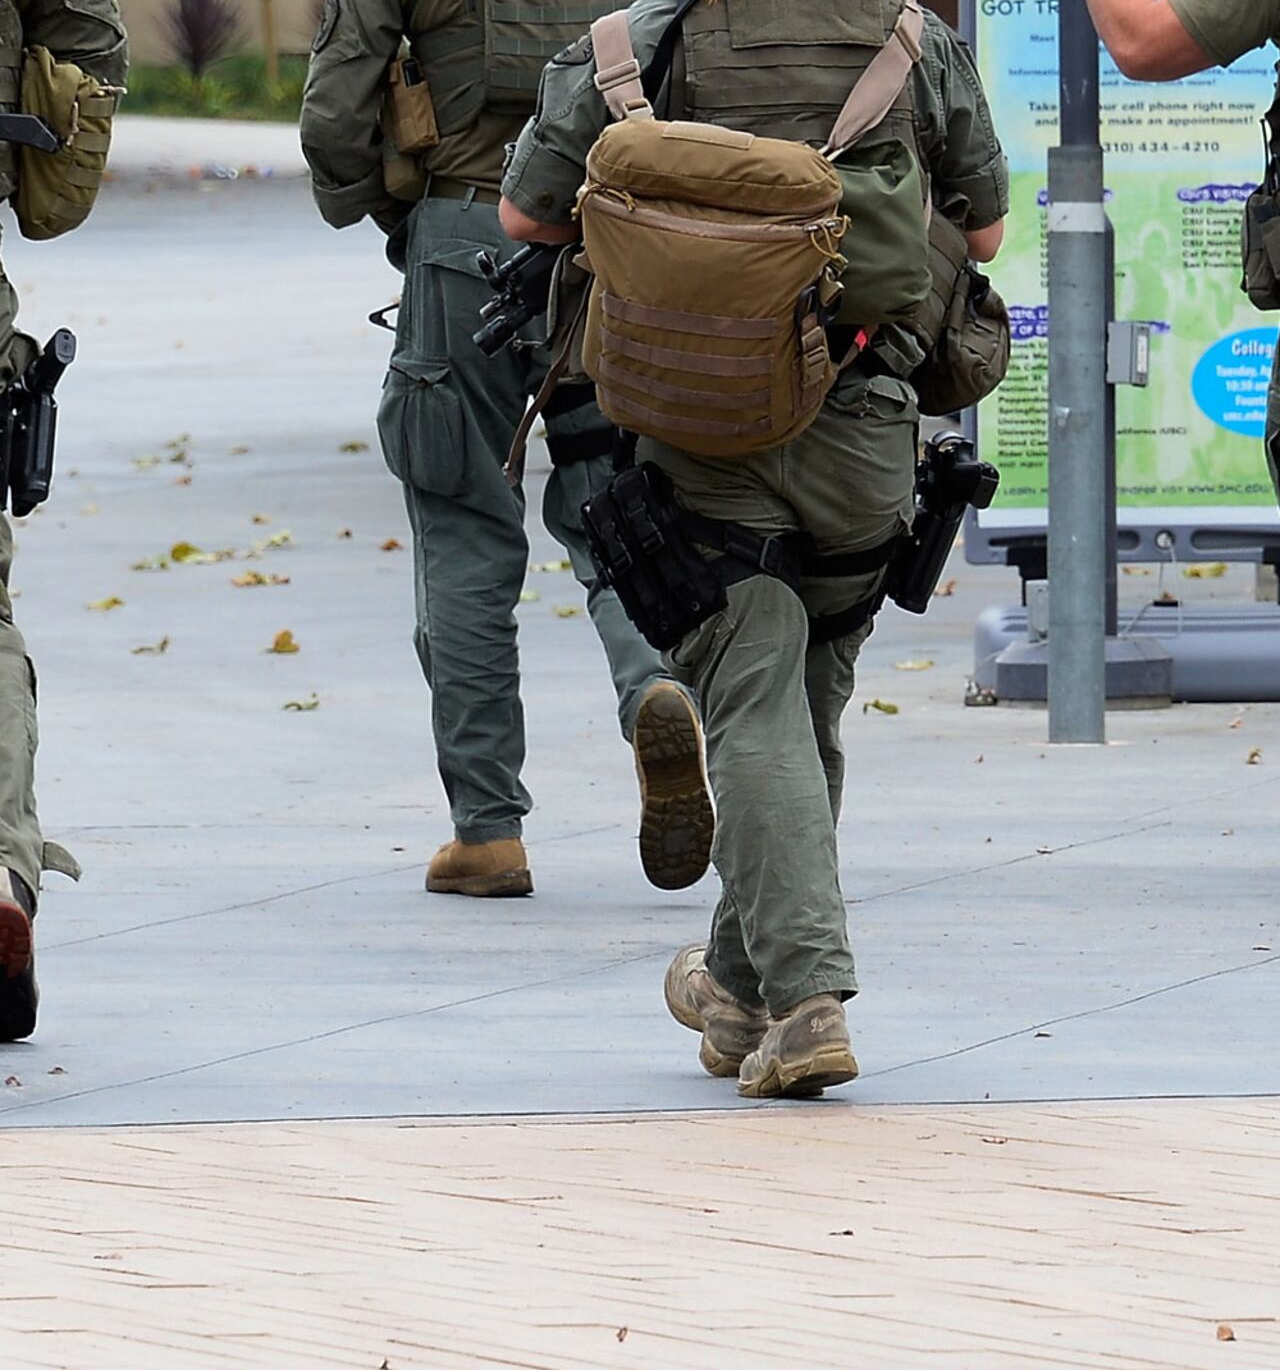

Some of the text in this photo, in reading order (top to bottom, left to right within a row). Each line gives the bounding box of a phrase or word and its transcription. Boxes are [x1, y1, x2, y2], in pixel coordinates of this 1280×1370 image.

[1028, 101, 1058, 112] Take
[1121, 101, 1145, 112] cell
[1148, 101, 1189, 114] phone
[1192, 101, 1223, 114] right
[1227, 103, 1256, 112] now
[1034, 117, 1058, 127] and
[1107, 117, 1143, 126] make
[1166, 115, 1254, 129] appointment!
